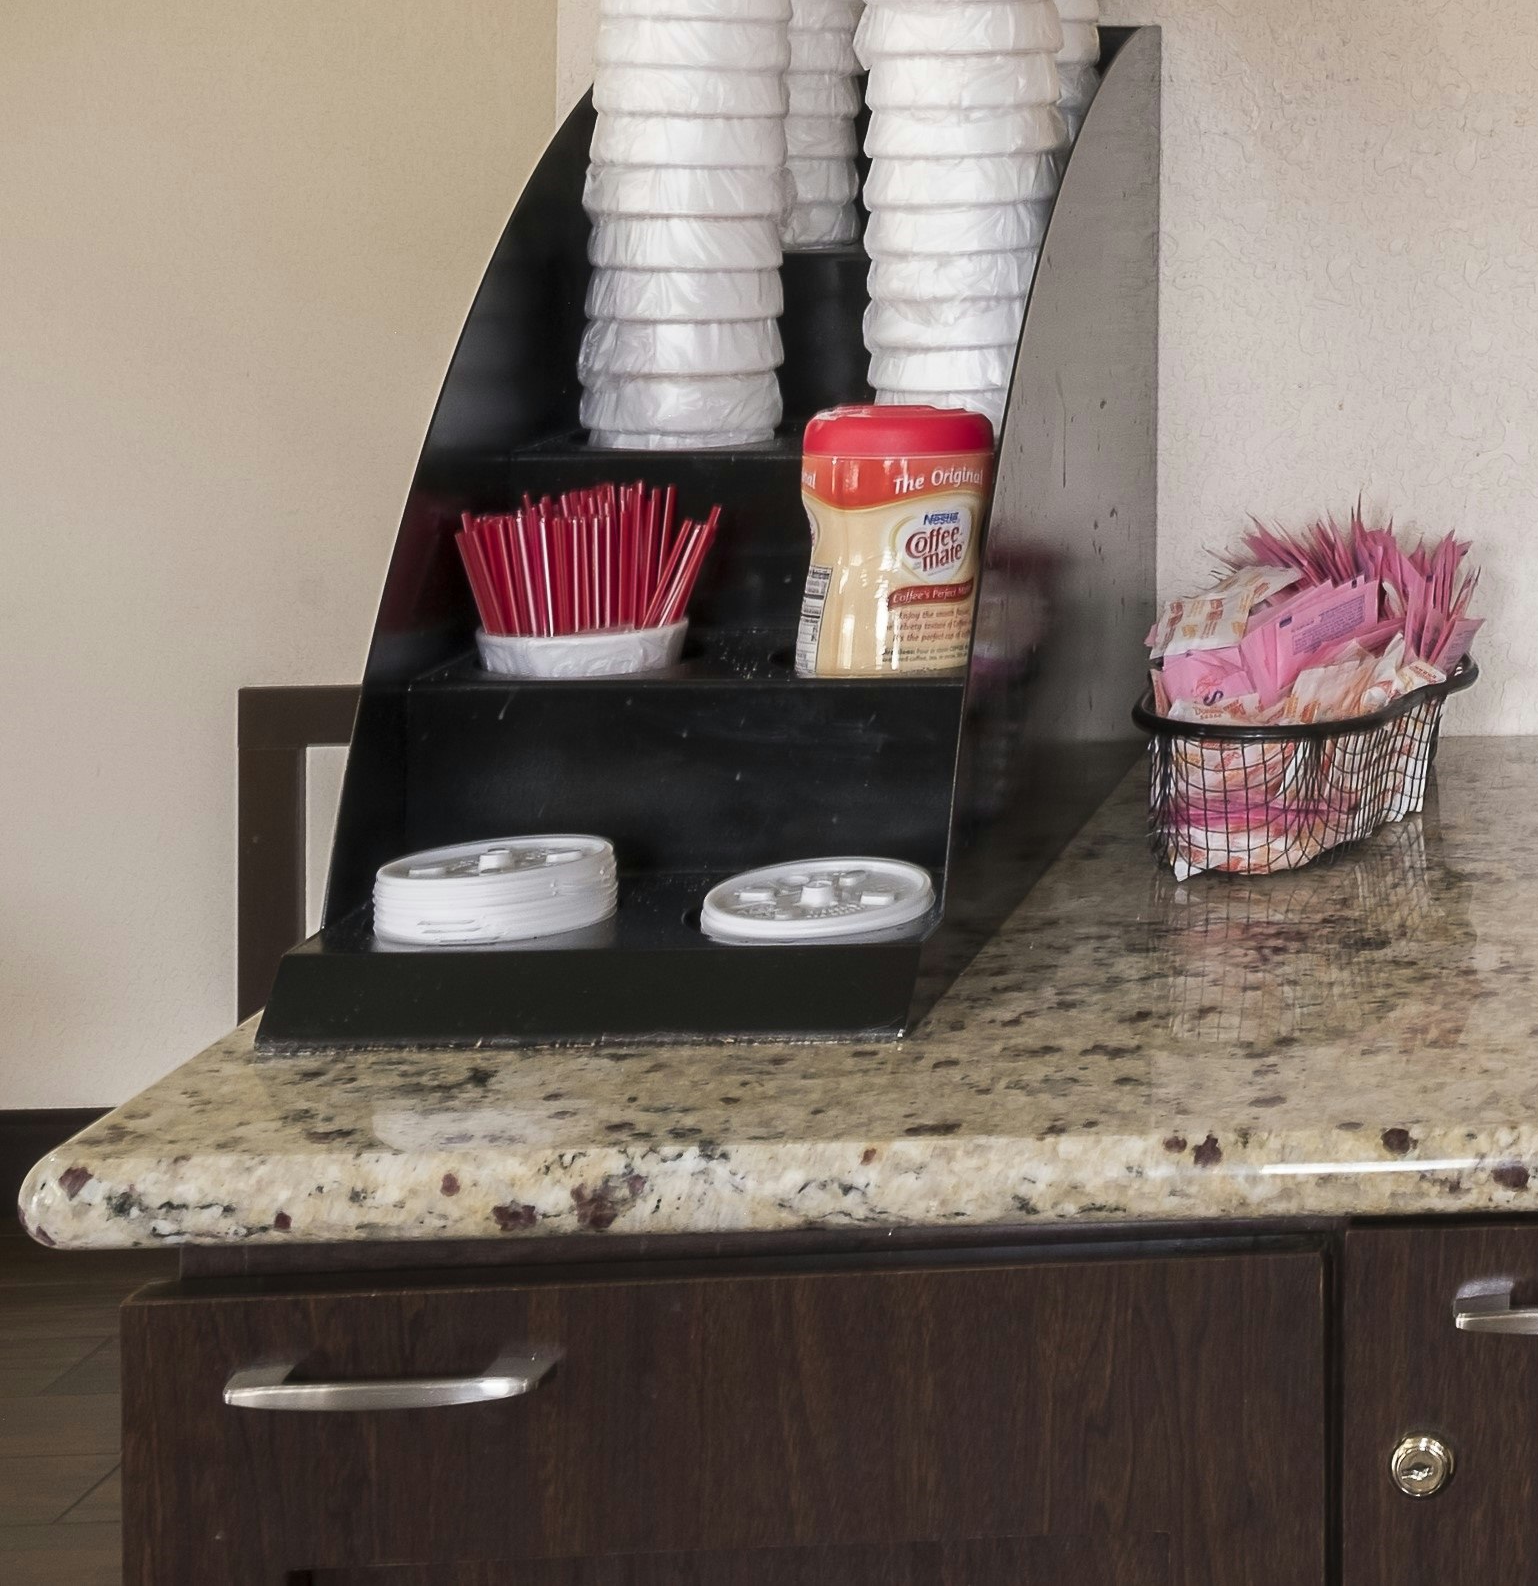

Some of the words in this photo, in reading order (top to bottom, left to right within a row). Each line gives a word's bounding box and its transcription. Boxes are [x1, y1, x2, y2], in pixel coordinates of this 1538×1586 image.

[893, 473, 925, 494] The
[931, 467, 983, 488] Original
[922, 543, 963, 572] mate
[893, 589, 930, 604] Coffee's
